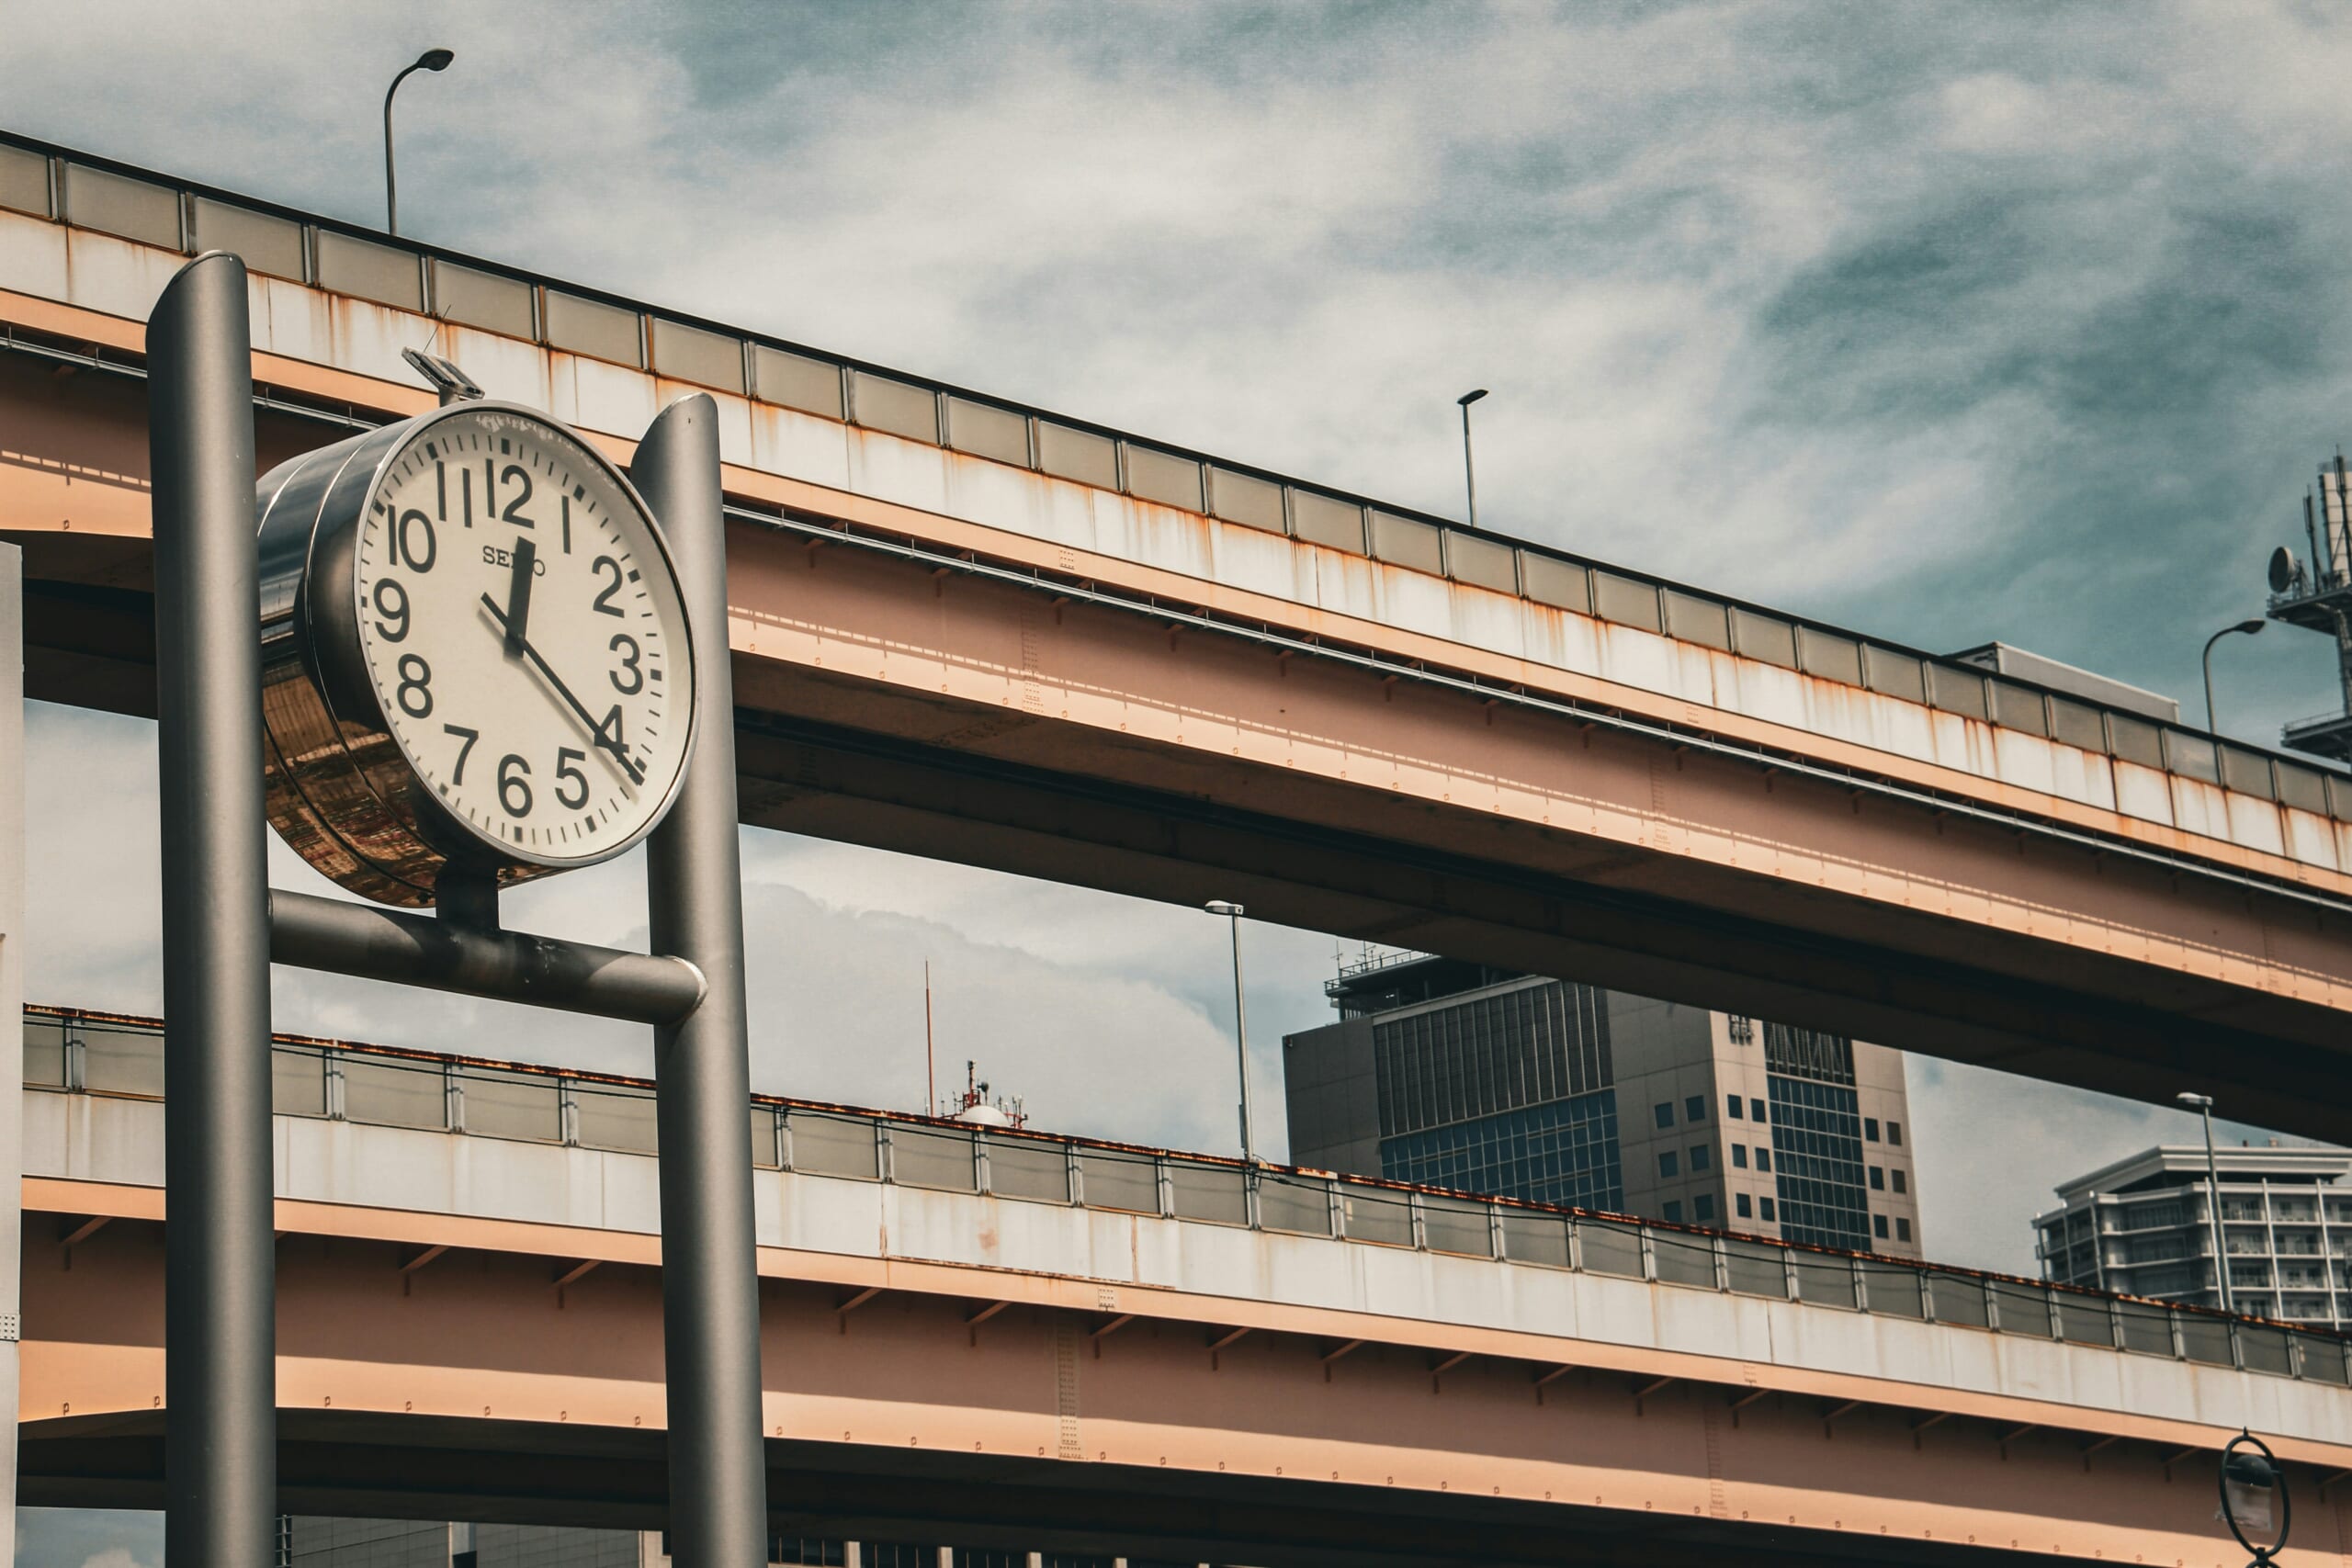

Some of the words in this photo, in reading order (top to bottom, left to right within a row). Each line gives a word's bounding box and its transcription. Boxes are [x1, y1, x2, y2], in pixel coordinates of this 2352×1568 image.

[485, 457, 535, 529] 12
[388, 504, 436, 573] 10
[562, 495, 571, 555] 1
[374, 578, 411, 643] 9
[593, 556, 625, 618] 2
[397, 654, 433, 718] 8
[609, 634, 644, 695] 3
[444, 724, 479, 785] 7
[594, 705, 629, 764] 4
[497, 754, 533, 818] 6
[555, 747, 589, 809] 5
